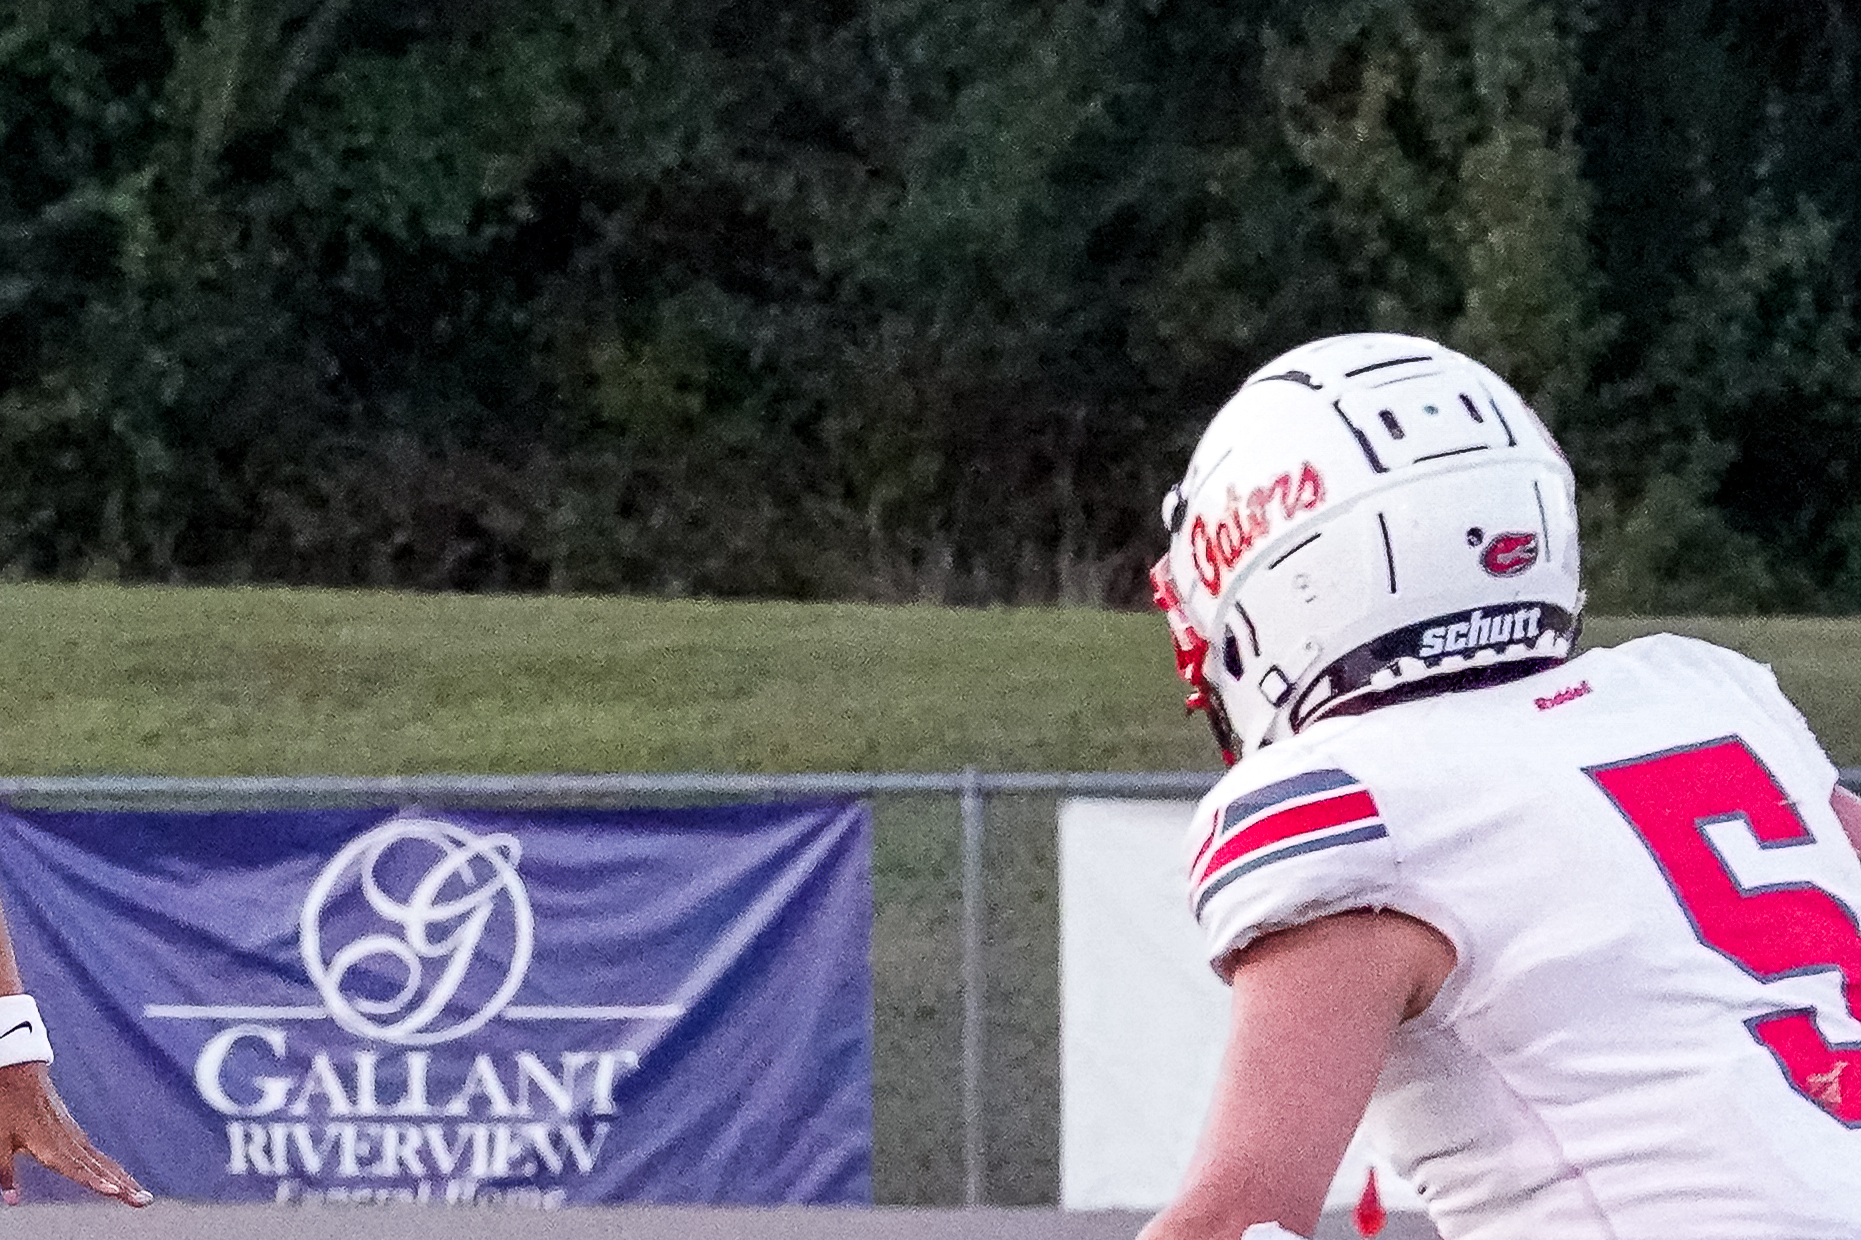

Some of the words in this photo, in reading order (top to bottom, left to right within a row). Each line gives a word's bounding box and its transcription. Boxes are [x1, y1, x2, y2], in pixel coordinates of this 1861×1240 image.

[1580, 733, 1861, 1131] 5
[194, 1023, 639, 1118] GALLANT
[227, 1121, 611, 1178] RIVERVIEW
